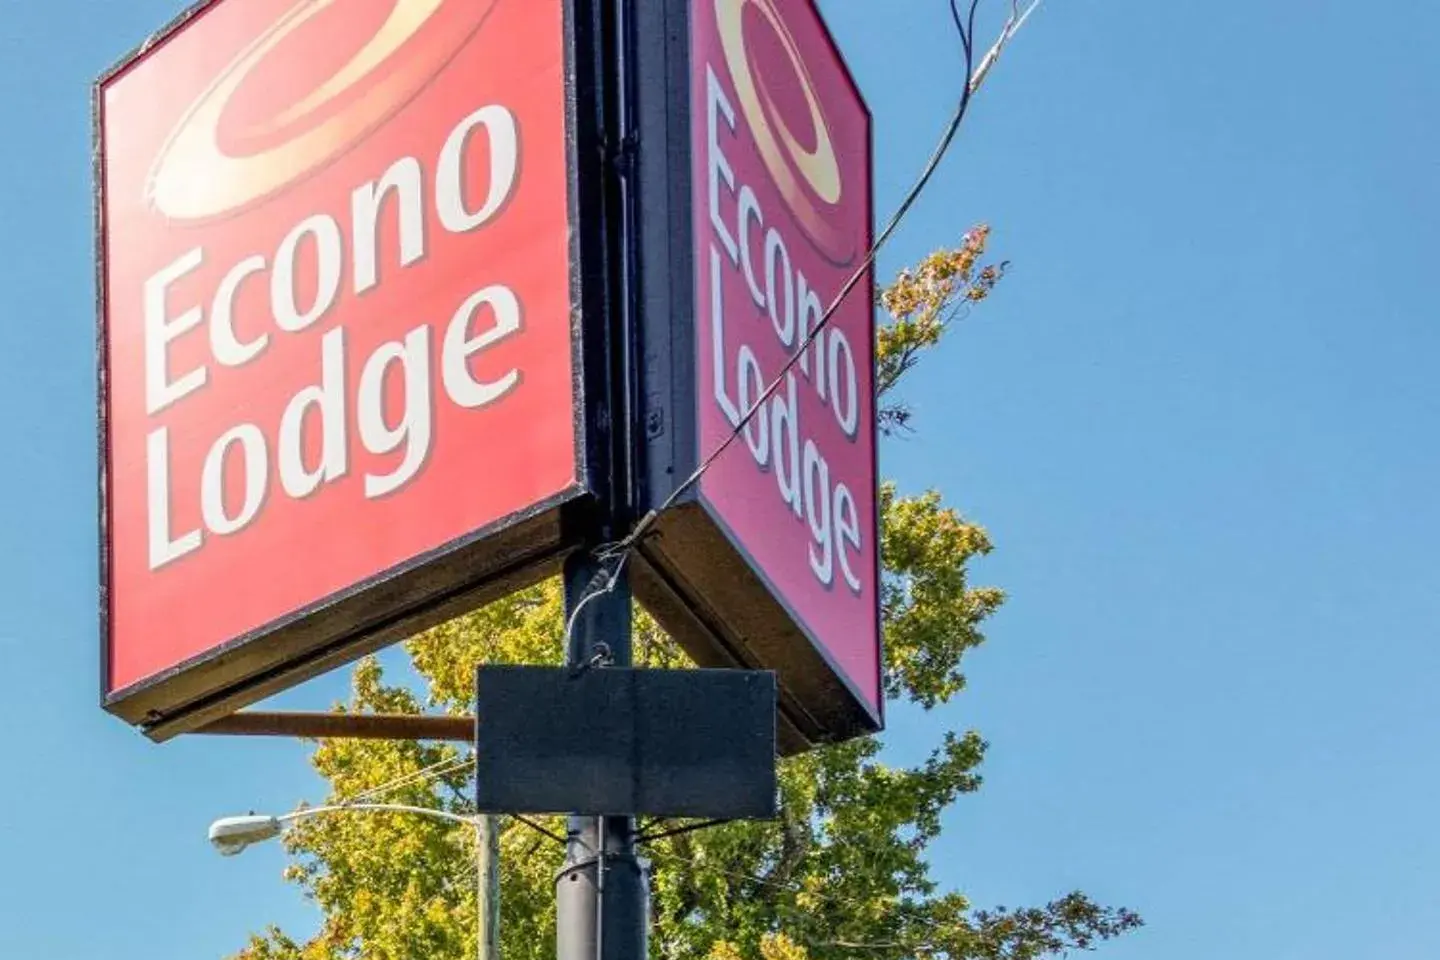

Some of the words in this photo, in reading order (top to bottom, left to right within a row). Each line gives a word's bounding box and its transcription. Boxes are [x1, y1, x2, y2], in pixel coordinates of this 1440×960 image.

[144, 104, 518, 415] Econo
[705, 62, 858, 438] Econo
[145, 284, 522, 571] Lodge
[709, 245, 862, 595] Lodge
